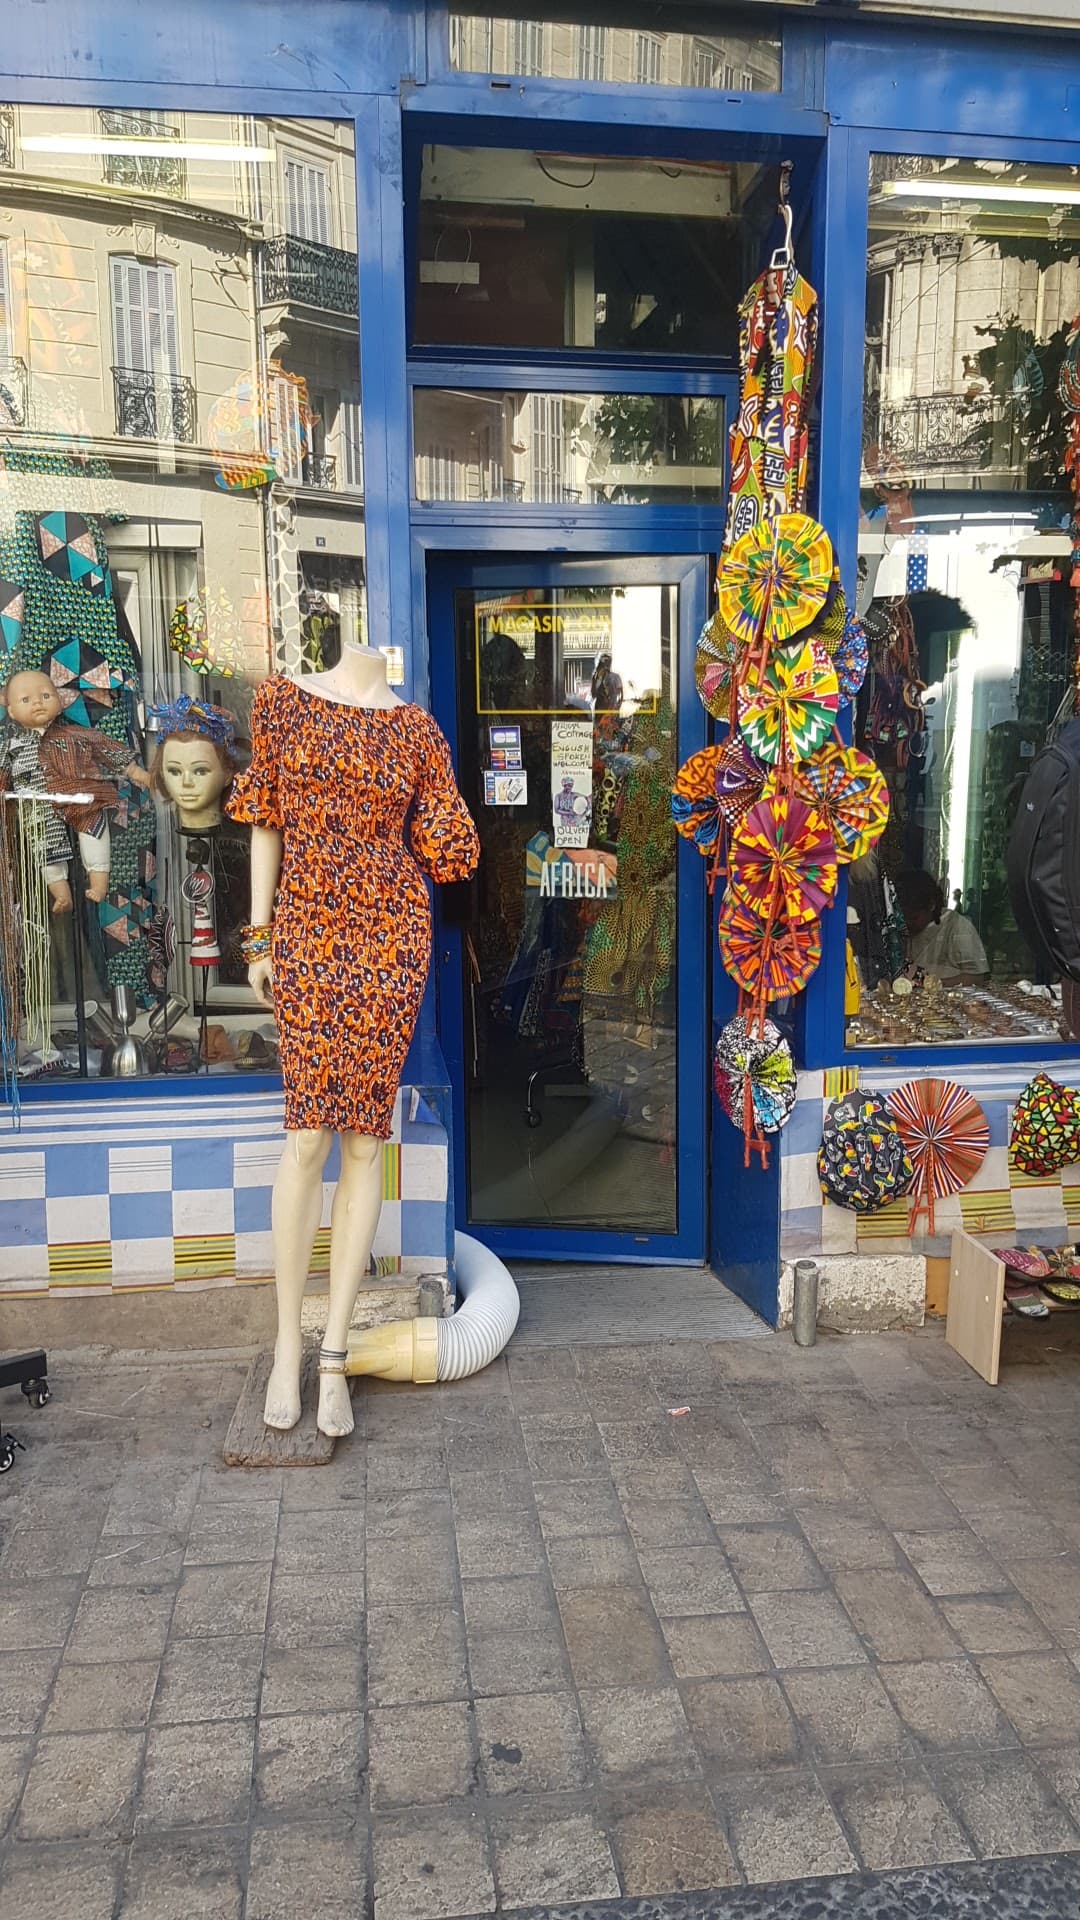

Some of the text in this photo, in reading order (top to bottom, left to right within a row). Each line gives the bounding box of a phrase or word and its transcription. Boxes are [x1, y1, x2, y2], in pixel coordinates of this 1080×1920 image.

[488, 615, 569, 633] MAGASIN
[552, 741, 590, 752] ENGLISH
[558, 752, 590, 760] SPOKEN
[552, 760, 590, 768] WELCOME
[557, 826, 589, 835] OUVERT
[556, 836, 582, 846] OPEN
[540, 861, 608, 898] AFRICA
